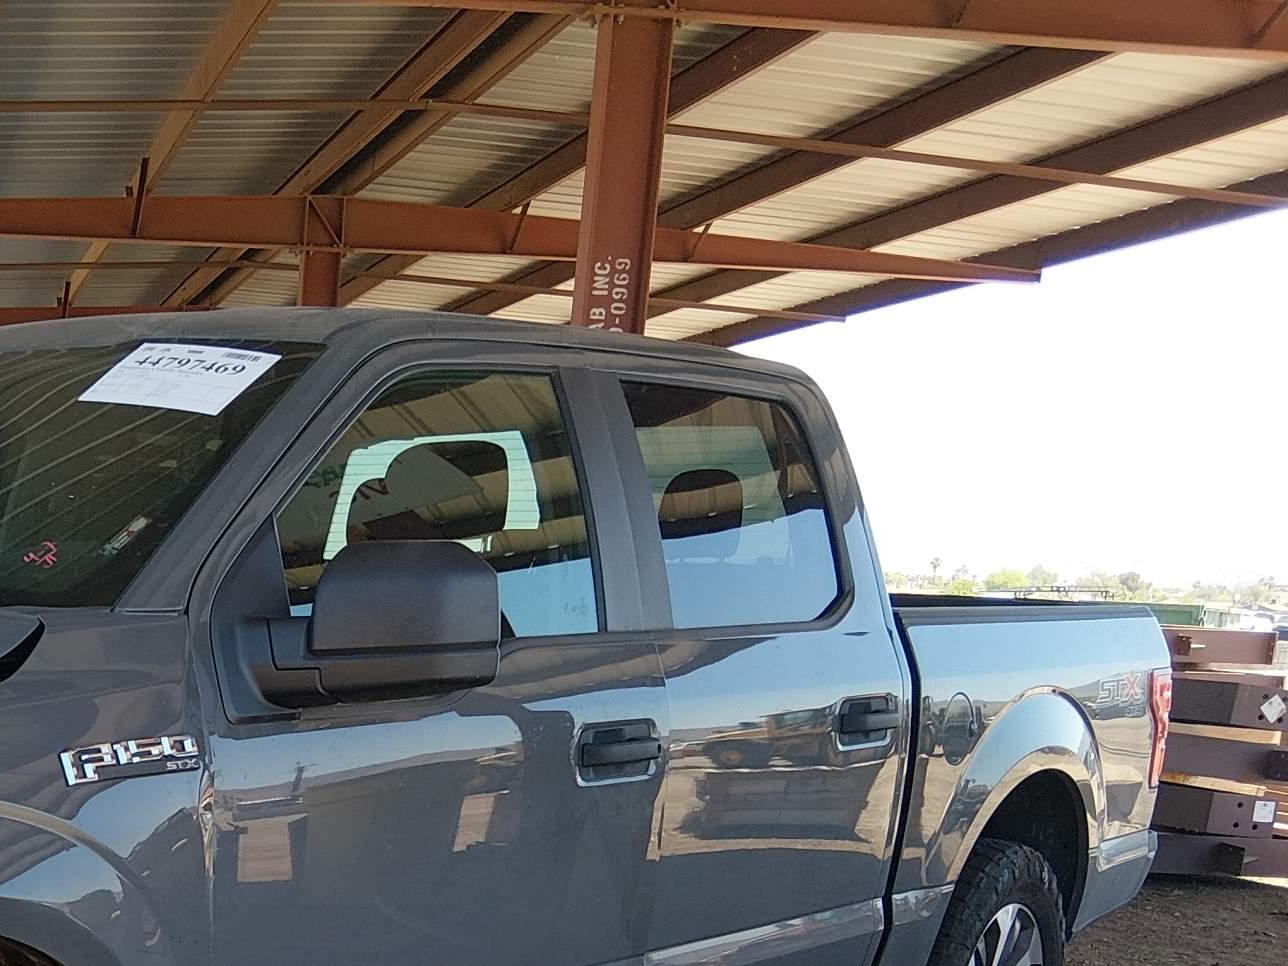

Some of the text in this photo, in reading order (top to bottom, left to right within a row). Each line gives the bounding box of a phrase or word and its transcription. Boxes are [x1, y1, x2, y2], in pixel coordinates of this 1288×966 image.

[591, 255, 612, 296] INC.
[609, 258, 631, 333] -0969
[134, 355, 247, 376] 44797469
[1096, 672, 1143, 704] STX
[166, 758, 200, 770] STX
